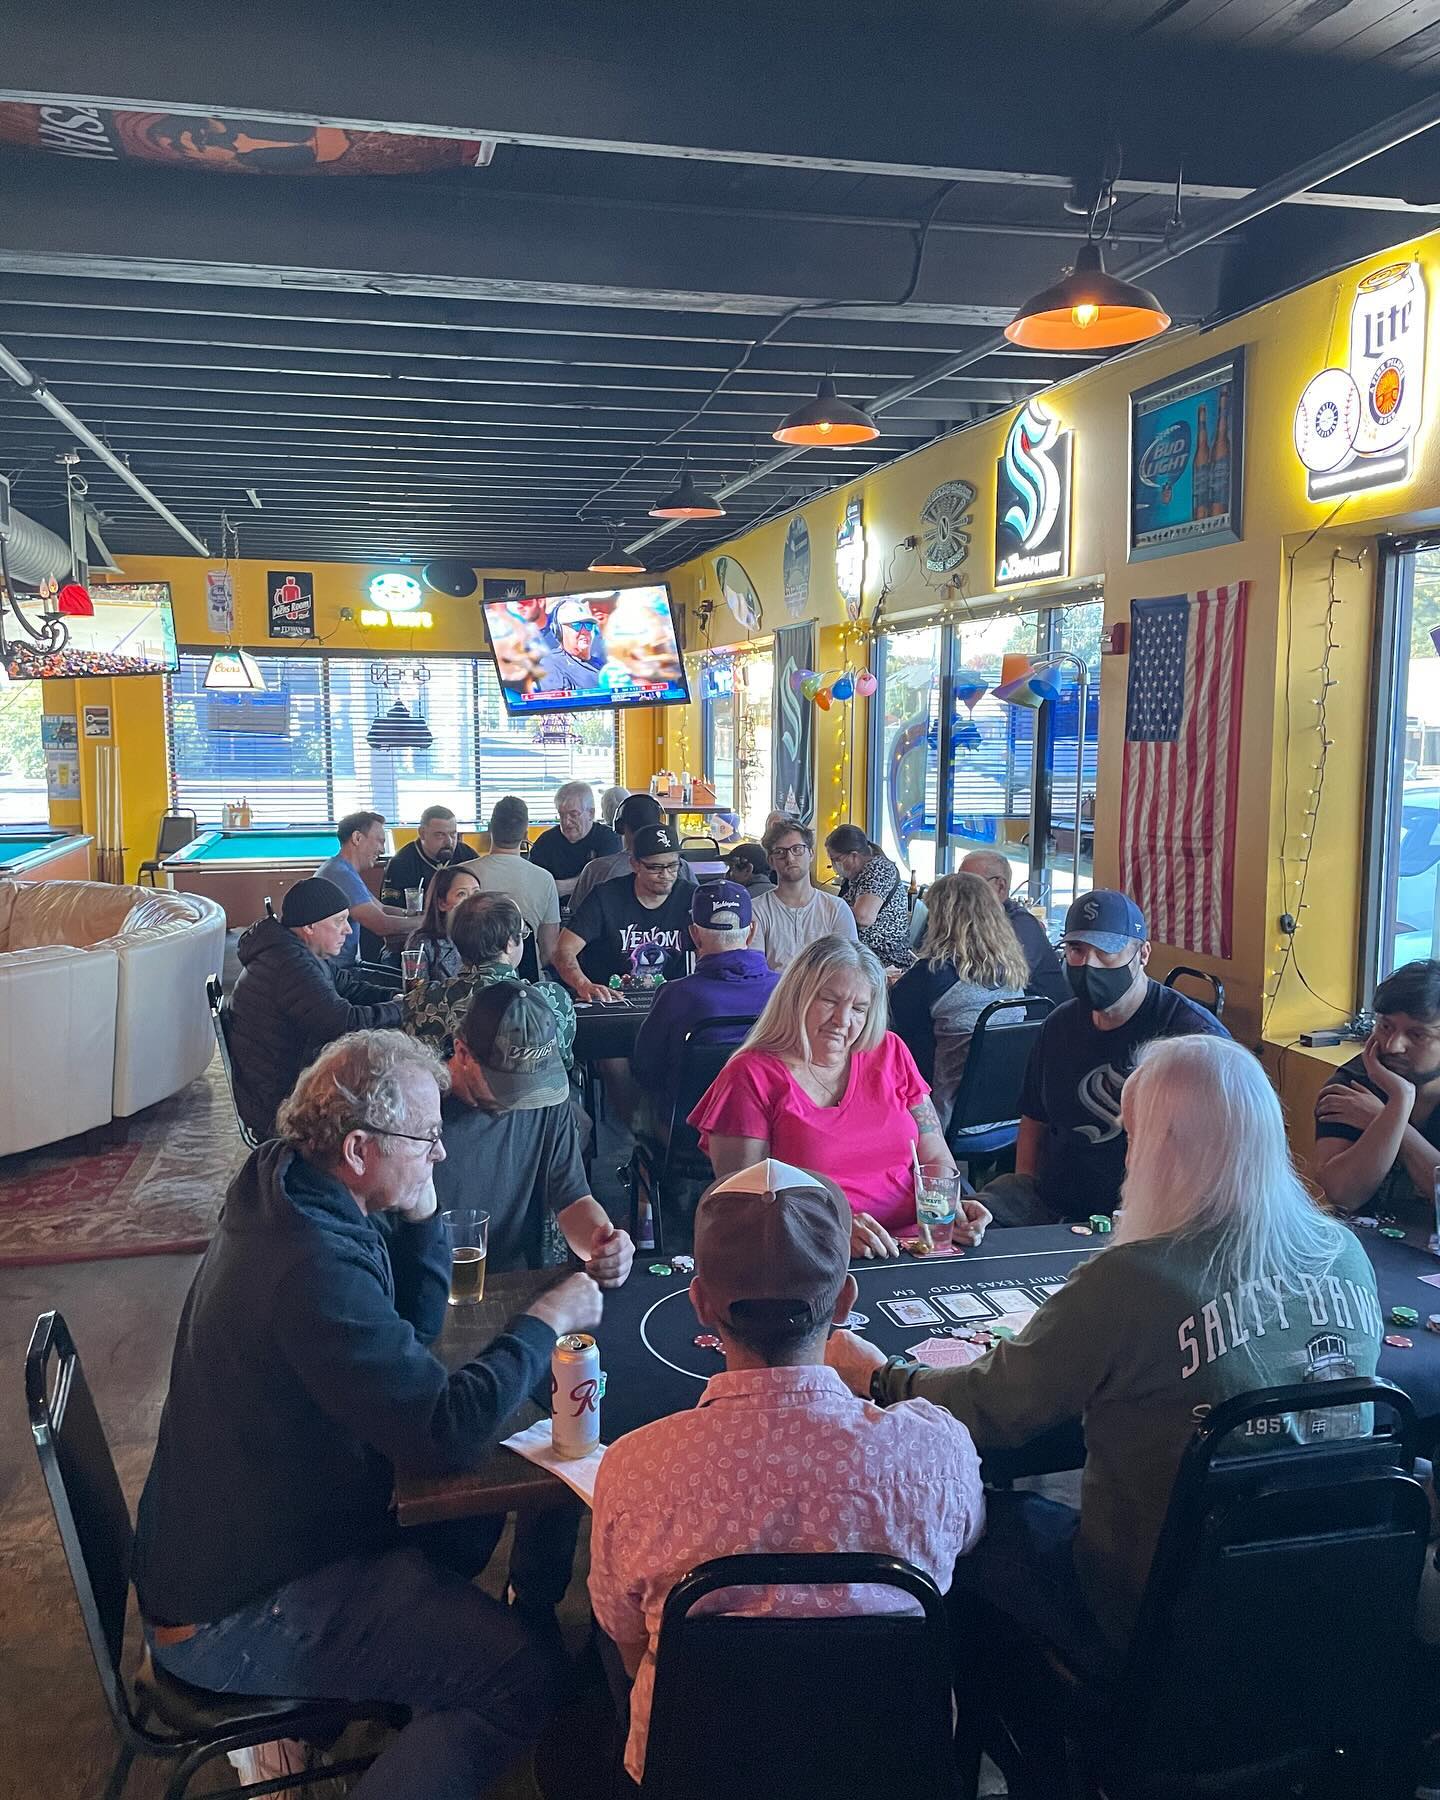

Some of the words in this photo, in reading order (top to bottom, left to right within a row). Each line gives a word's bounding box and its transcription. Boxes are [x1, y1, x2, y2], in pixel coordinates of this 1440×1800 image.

[1154, 439, 1185, 460] BUD
[1146, 453, 1190, 478] LIGHT
[619, 923, 681, 952] VENOM
[976, 1279, 1025, 1289] TEXAS
[1028, 1275, 1069, 1284] LIMIT
[892, 1289, 916, 1297] EM
[930, 1326, 954, 1335] NO
[1177, 1275, 1291, 1380] SALTY
[1300, 1273, 1383, 1338] DAW
[1244, 1414, 1294, 1437] 1957
